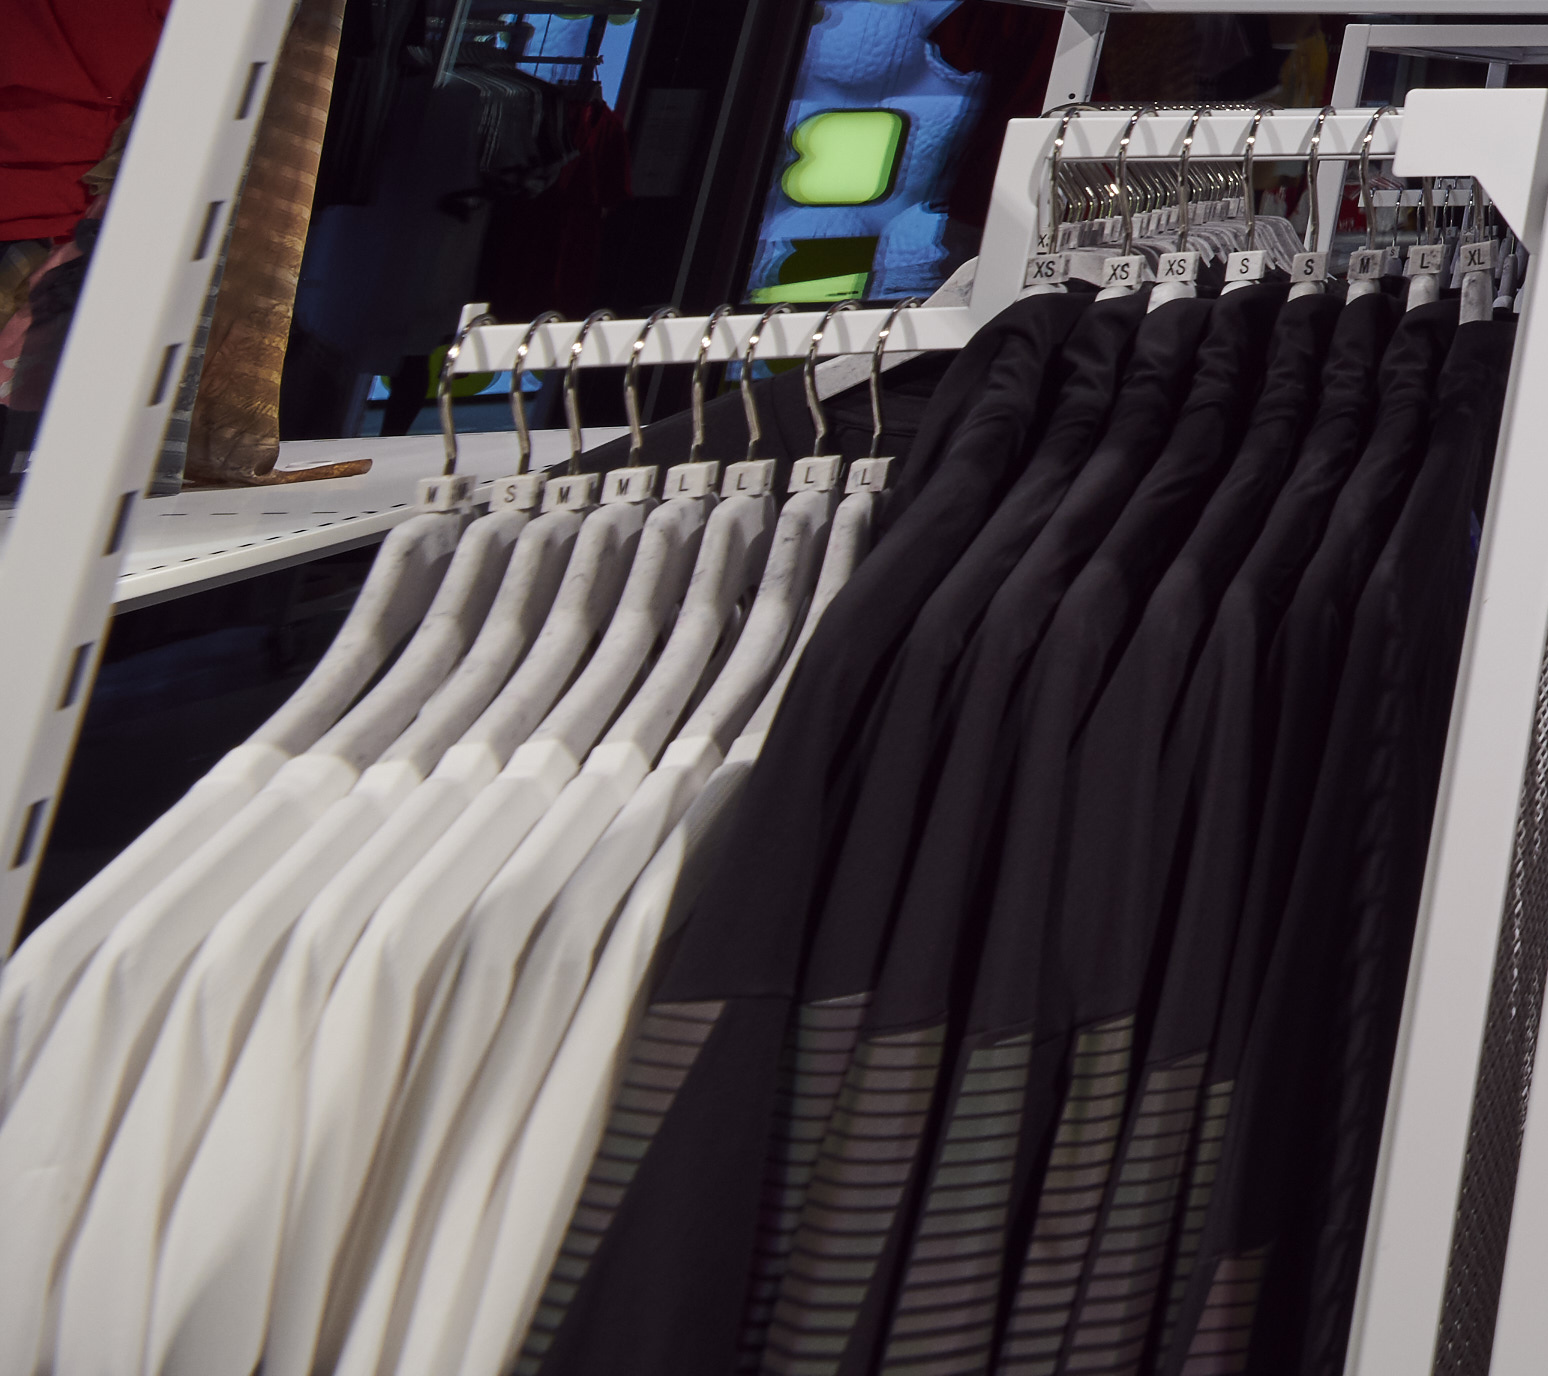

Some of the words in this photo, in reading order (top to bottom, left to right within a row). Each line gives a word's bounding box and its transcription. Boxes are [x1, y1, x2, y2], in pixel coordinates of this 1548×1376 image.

[1240, 258, 1249, 274] S
[1359, 256, 1370, 273] M
[1420, 253, 1429, 269] L
[1468, 249, 1485, 266] XL
[1033, 261, 1055, 278] XS
[1108, 264, 1130, 281] XS
[1166, 259, 1186, 276] XS
[1304, 259, 1314, 275] S
[679, 474, 689, 491] L
[737, 473, 747, 490] L
[805, 467, 814, 483] L
[861, 468, 871, 485] L
[505, 485, 516, 503] S
[616, 478, 630, 496] M
